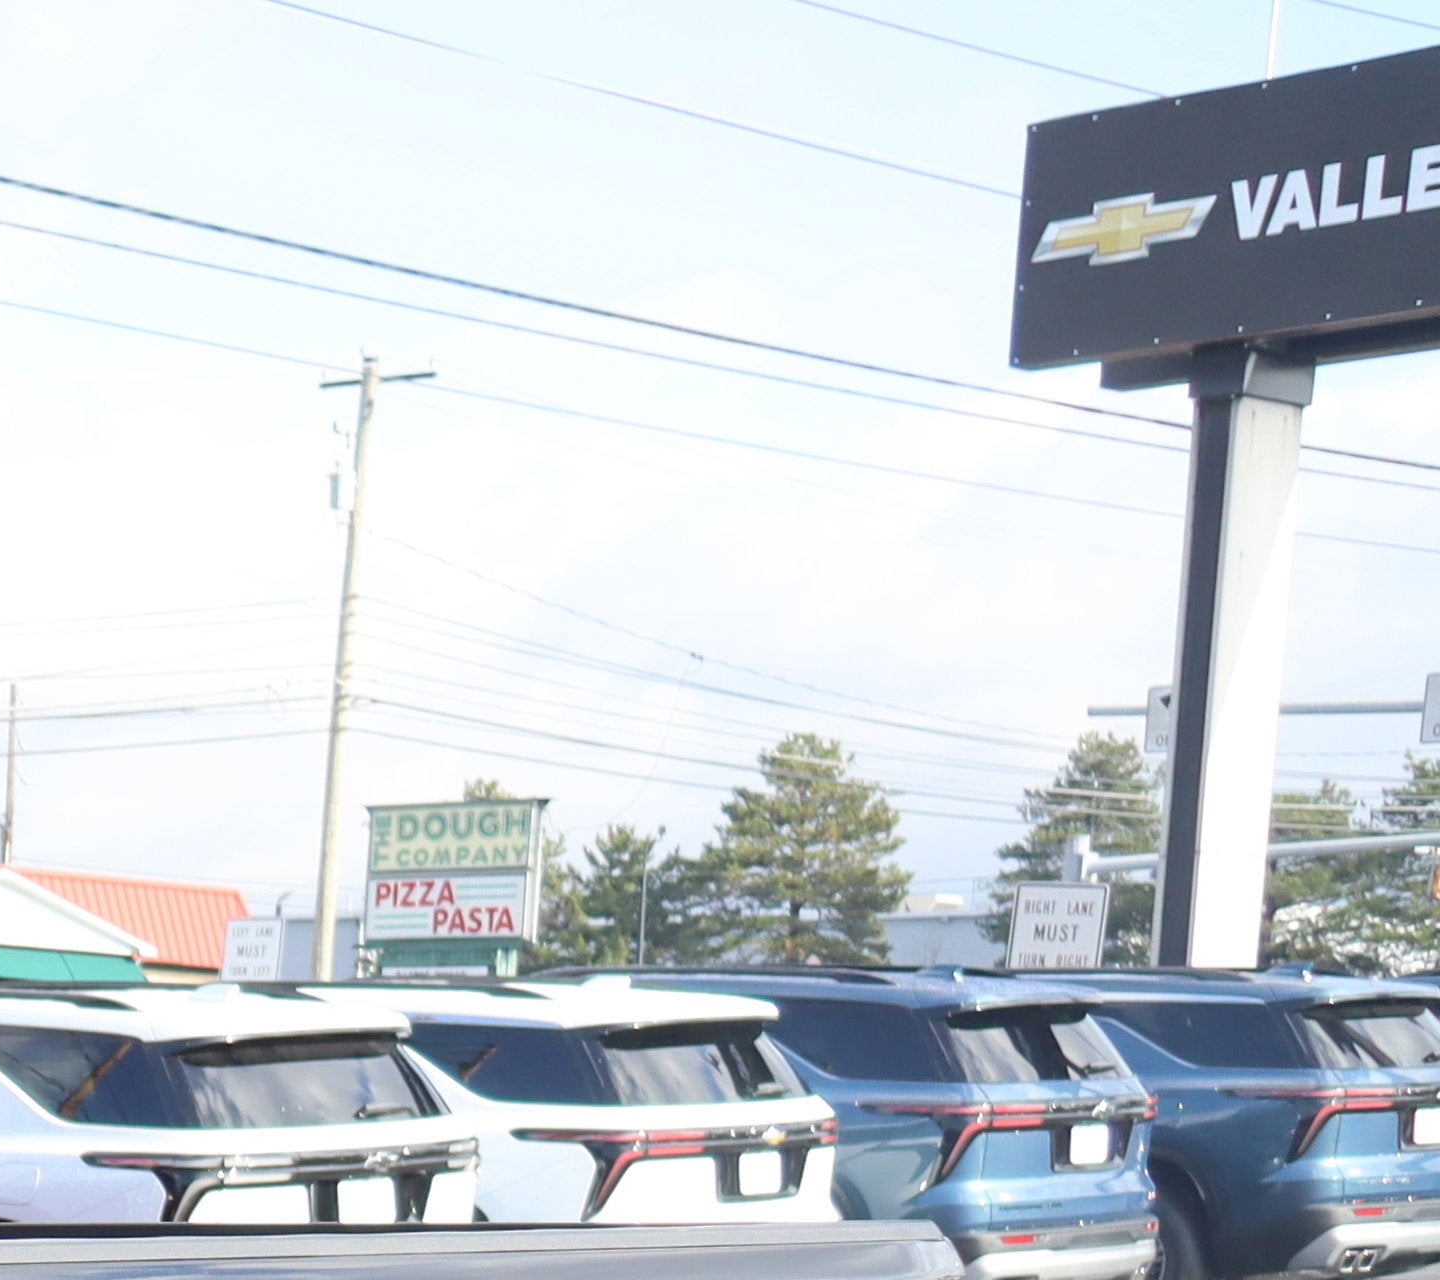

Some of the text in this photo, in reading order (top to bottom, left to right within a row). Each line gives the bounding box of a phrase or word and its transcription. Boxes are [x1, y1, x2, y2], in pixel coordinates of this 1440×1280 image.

[398, 809, 528, 842] DOUGH
[374, 813, 391, 866] THE
[396, 845, 526, 867] COMPANY
[375, 880, 455, 907] PIZZA
[1023, 900, 1094, 917] RIGHT LANE
[433, 906, 515, 934] PASTA
[232, 926, 273, 938] LEFT LANE
[1033, 924, 1080, 943] MUST
[236, 945, 265, 957] MUST
[1017, 953, 1089, 967] TURN RIGHT
